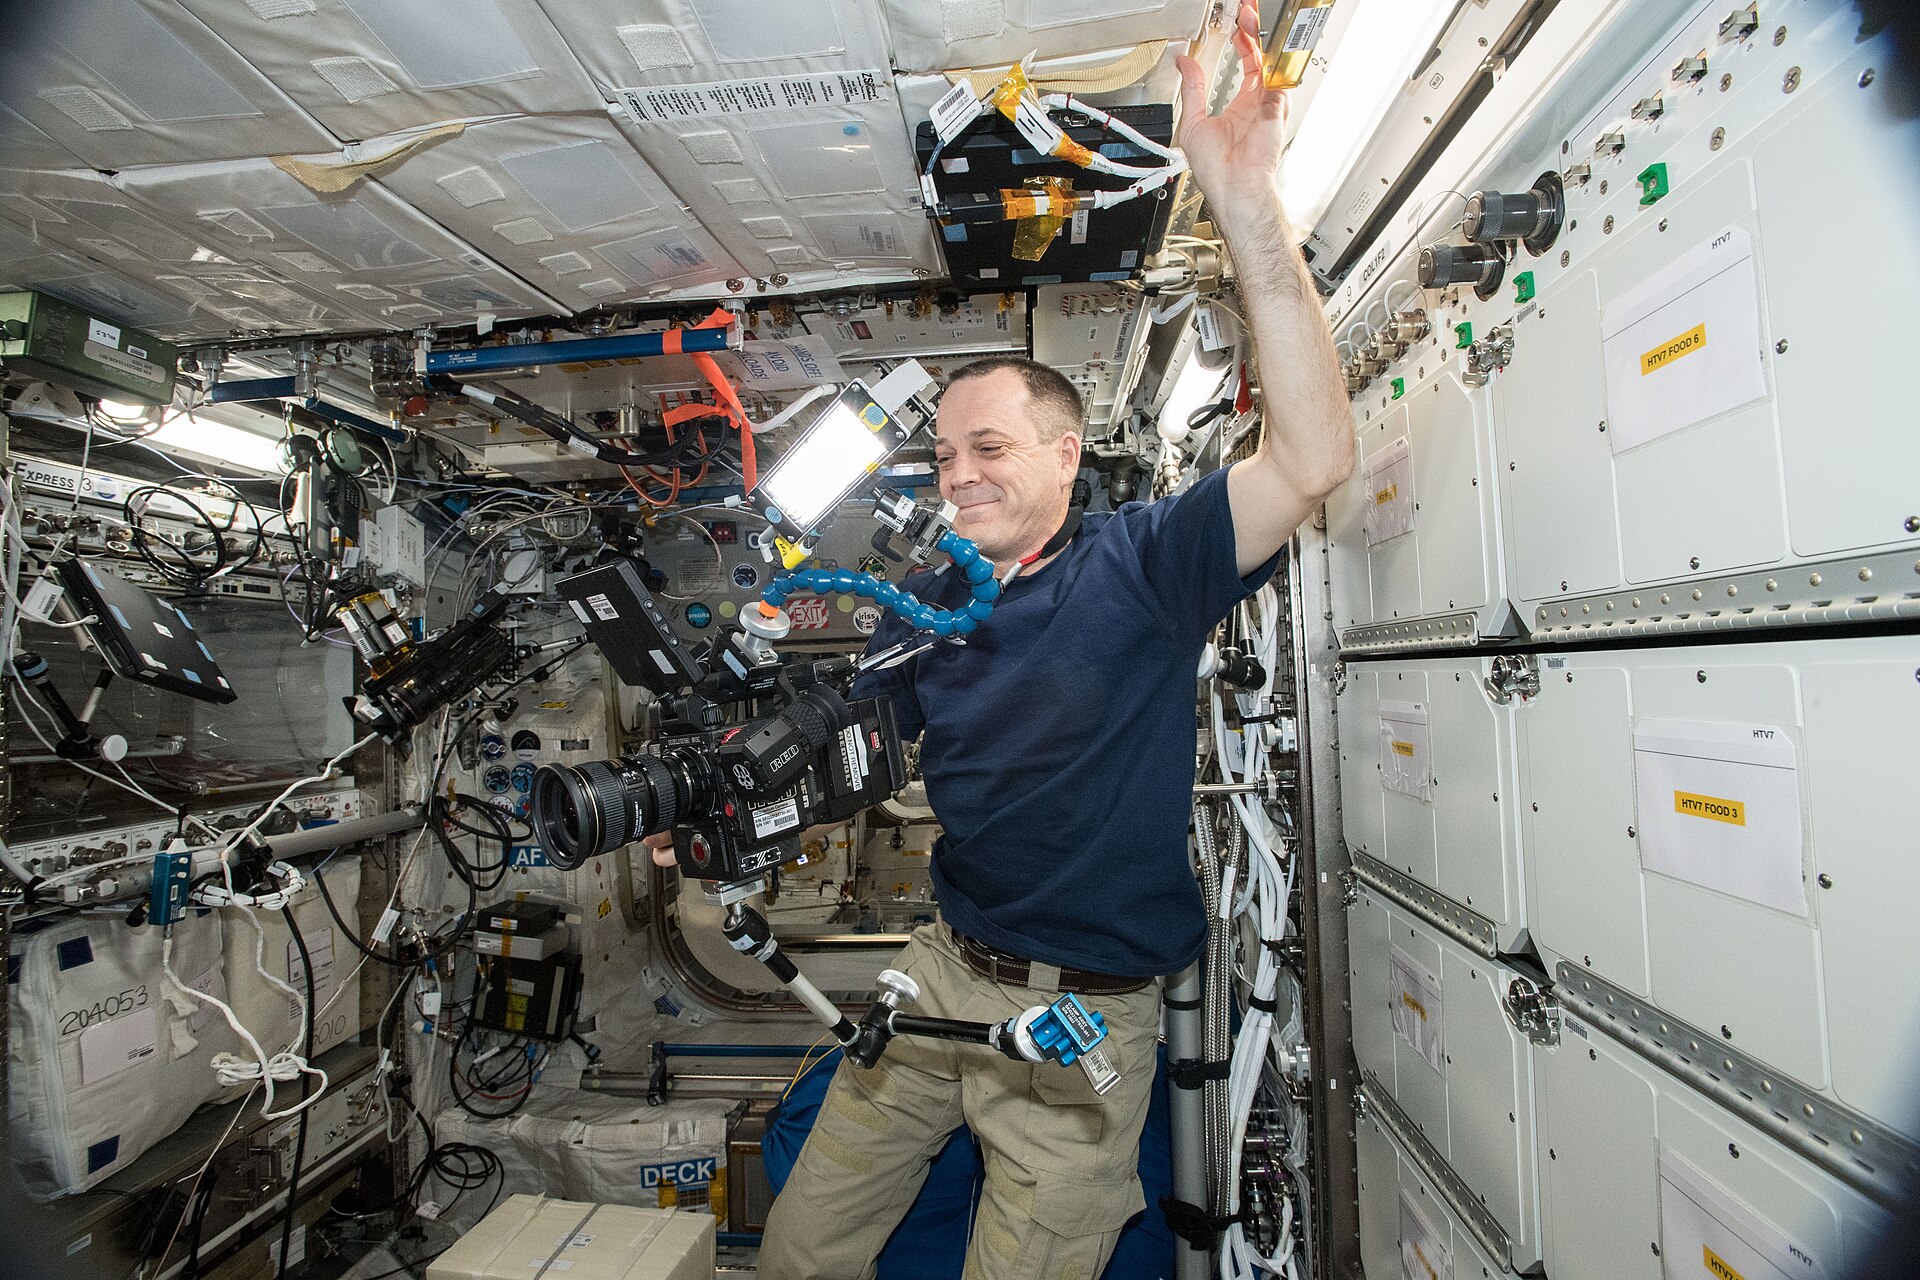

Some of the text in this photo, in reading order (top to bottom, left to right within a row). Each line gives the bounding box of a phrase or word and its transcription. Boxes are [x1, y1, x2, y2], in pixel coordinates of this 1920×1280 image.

[1710, 231, 1730, 249] HTV7
[1363, 248, 1387, 281] COL1F2
[761, 350, 790, 372] AVOID
[1648, 334, 1699, 367] HTV7 FOOD 6
[82, 477, 92, 492] 3
[794, 605, 821, 624] EXIT
[858, 611, 877, 621] iriss
[1753, 730, 1774, 739] HTV7
[769, 744, 800, 772] RED
[837, 731, 852, 788] REDVOLT
[849, 757, 861, 789] REMOVE
[1682, 799, 1738, 818] HTV7 FOOD 3
[59, 985, 148, 1036] 204053
[1067, 1001, 1087, 1027] CLAMP ASSY
[644, 1160, 714, 1187] DECK
[1789, 1244, 1813, 1266] HTV7
[1711, 1258, 1734, 1280] HTV7
